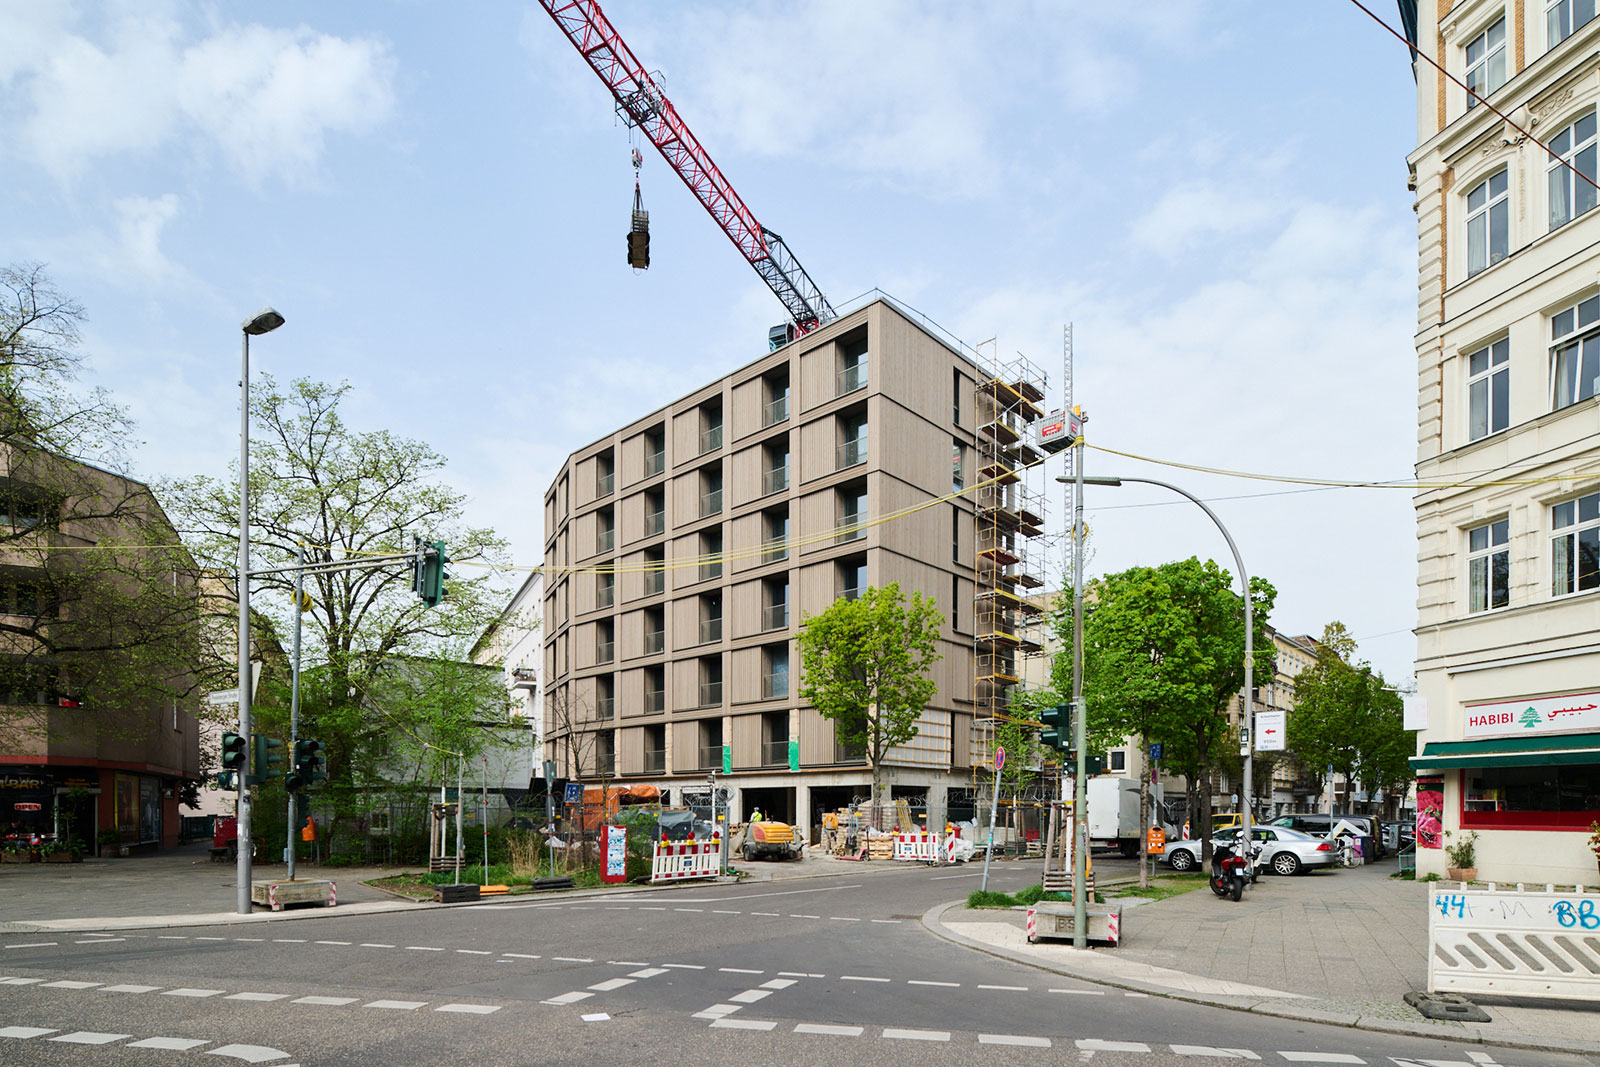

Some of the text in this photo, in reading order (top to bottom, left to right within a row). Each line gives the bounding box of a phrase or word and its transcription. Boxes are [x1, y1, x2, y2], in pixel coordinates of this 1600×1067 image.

[1469, 712, 1514, 727] HABIBI
[1547, 703, 1598, 721] حبيبي
[15, 803, 41, 811] OPEN
